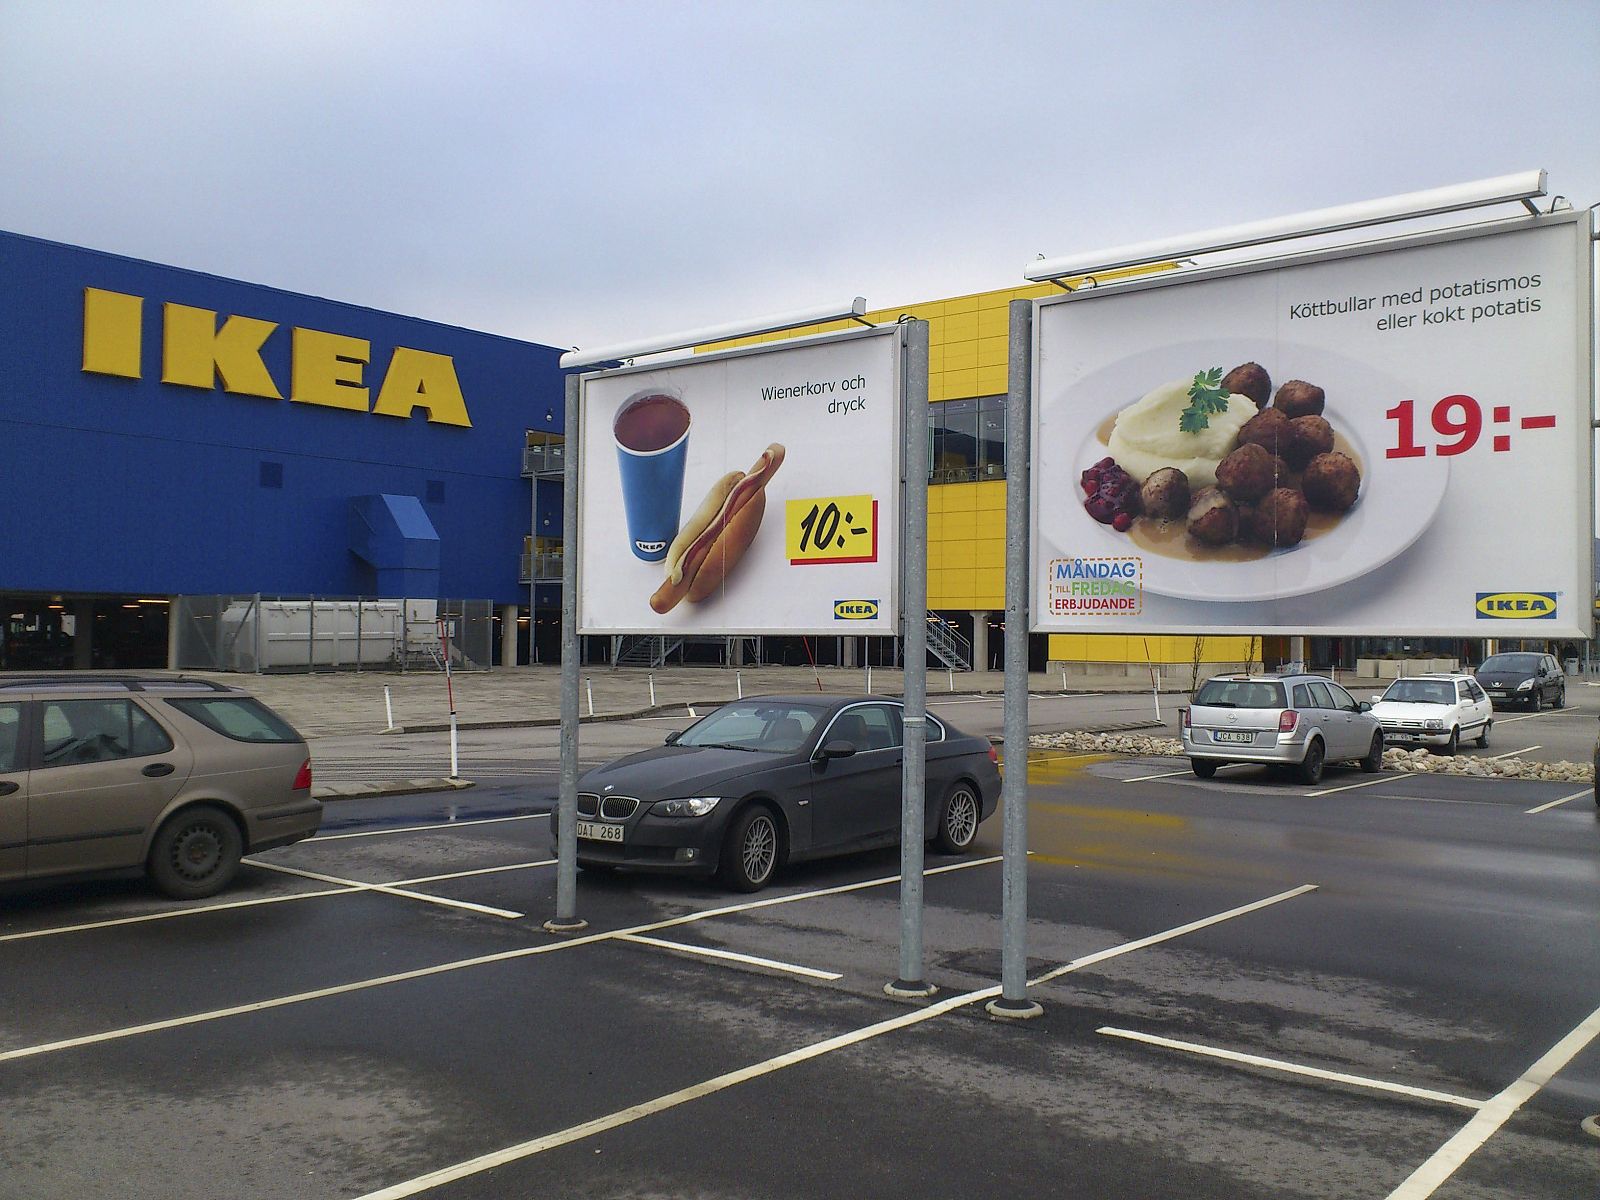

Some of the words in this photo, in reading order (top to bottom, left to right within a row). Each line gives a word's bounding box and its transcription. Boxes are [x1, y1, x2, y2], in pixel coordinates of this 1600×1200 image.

[1290, 296, 1376, 320] Köttbullar
[1382, 287, 1423, 308] med
[1430, 274, 1542, 305] potatismos
[1376, 313, 1417, 331] eller
[1423, 305, 1465, 325] kokt
[1471, 296, 1542, 323] potatis
[81, 286, 473, 428] IKEA
[761, 381, 836, 401] Wienerkorv
[841, 374, 866, 391] och
[827, 396, 866, 416] dryck
[1386, 394, 1556, 459] 19:-
[800, 502, 868, 552] 10:-
[638, 542, 663, 550] IKEA
[1056, 558, 1136, 579] MÅNDAG
[1055, 585, 1071, 594] TILL
[1071, 580, 1136, 596] FREDAG
[839, 605, 874, 614] IKEA
[1055, 598, 1135, 610] ERBJUDANDE
[1486, 600, 1548, 611] IKEA
[1218, 732, 1232, 740] JCA
[600, 826, 621, 840] 268
